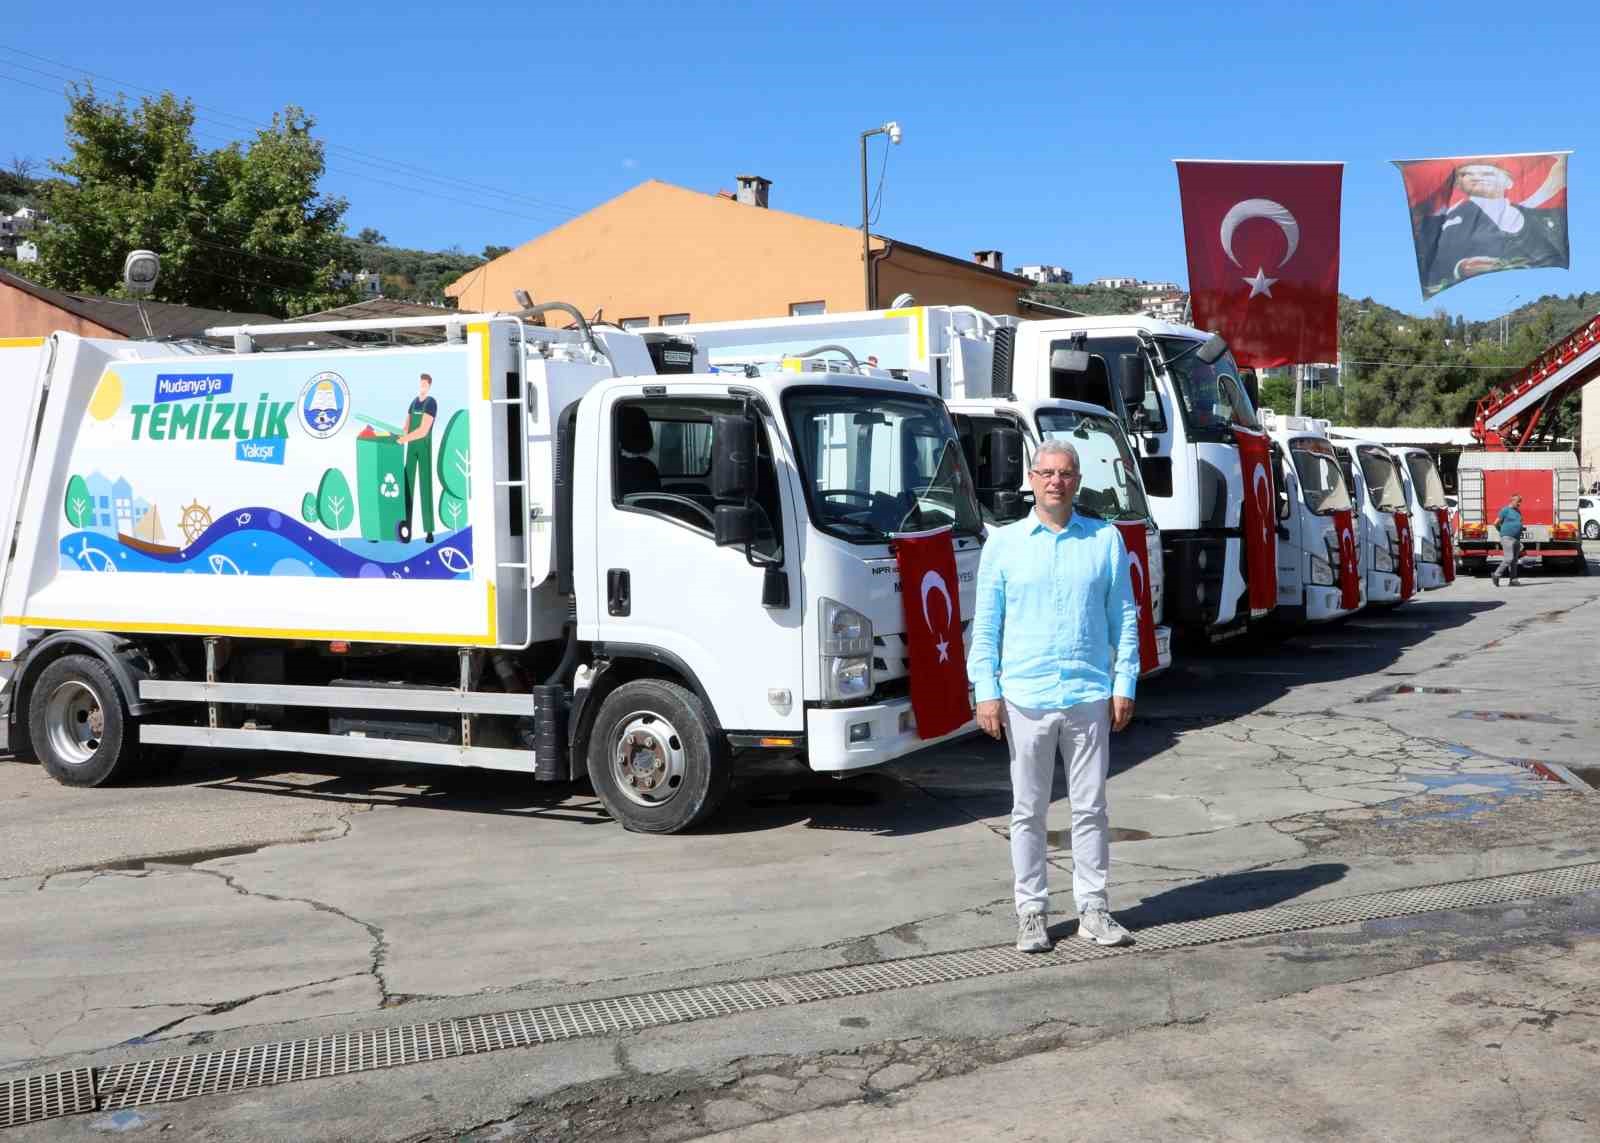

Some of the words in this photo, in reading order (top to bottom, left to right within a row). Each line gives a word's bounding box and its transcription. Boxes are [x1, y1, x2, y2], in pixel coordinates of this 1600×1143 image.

[159, 376, 222, 394] Mudanya'ya
[130, 392, 295, 440] TEMİZLİK
[241, 443, 274, 460] Yakışır
[872, 566, 891, 576] NPR
